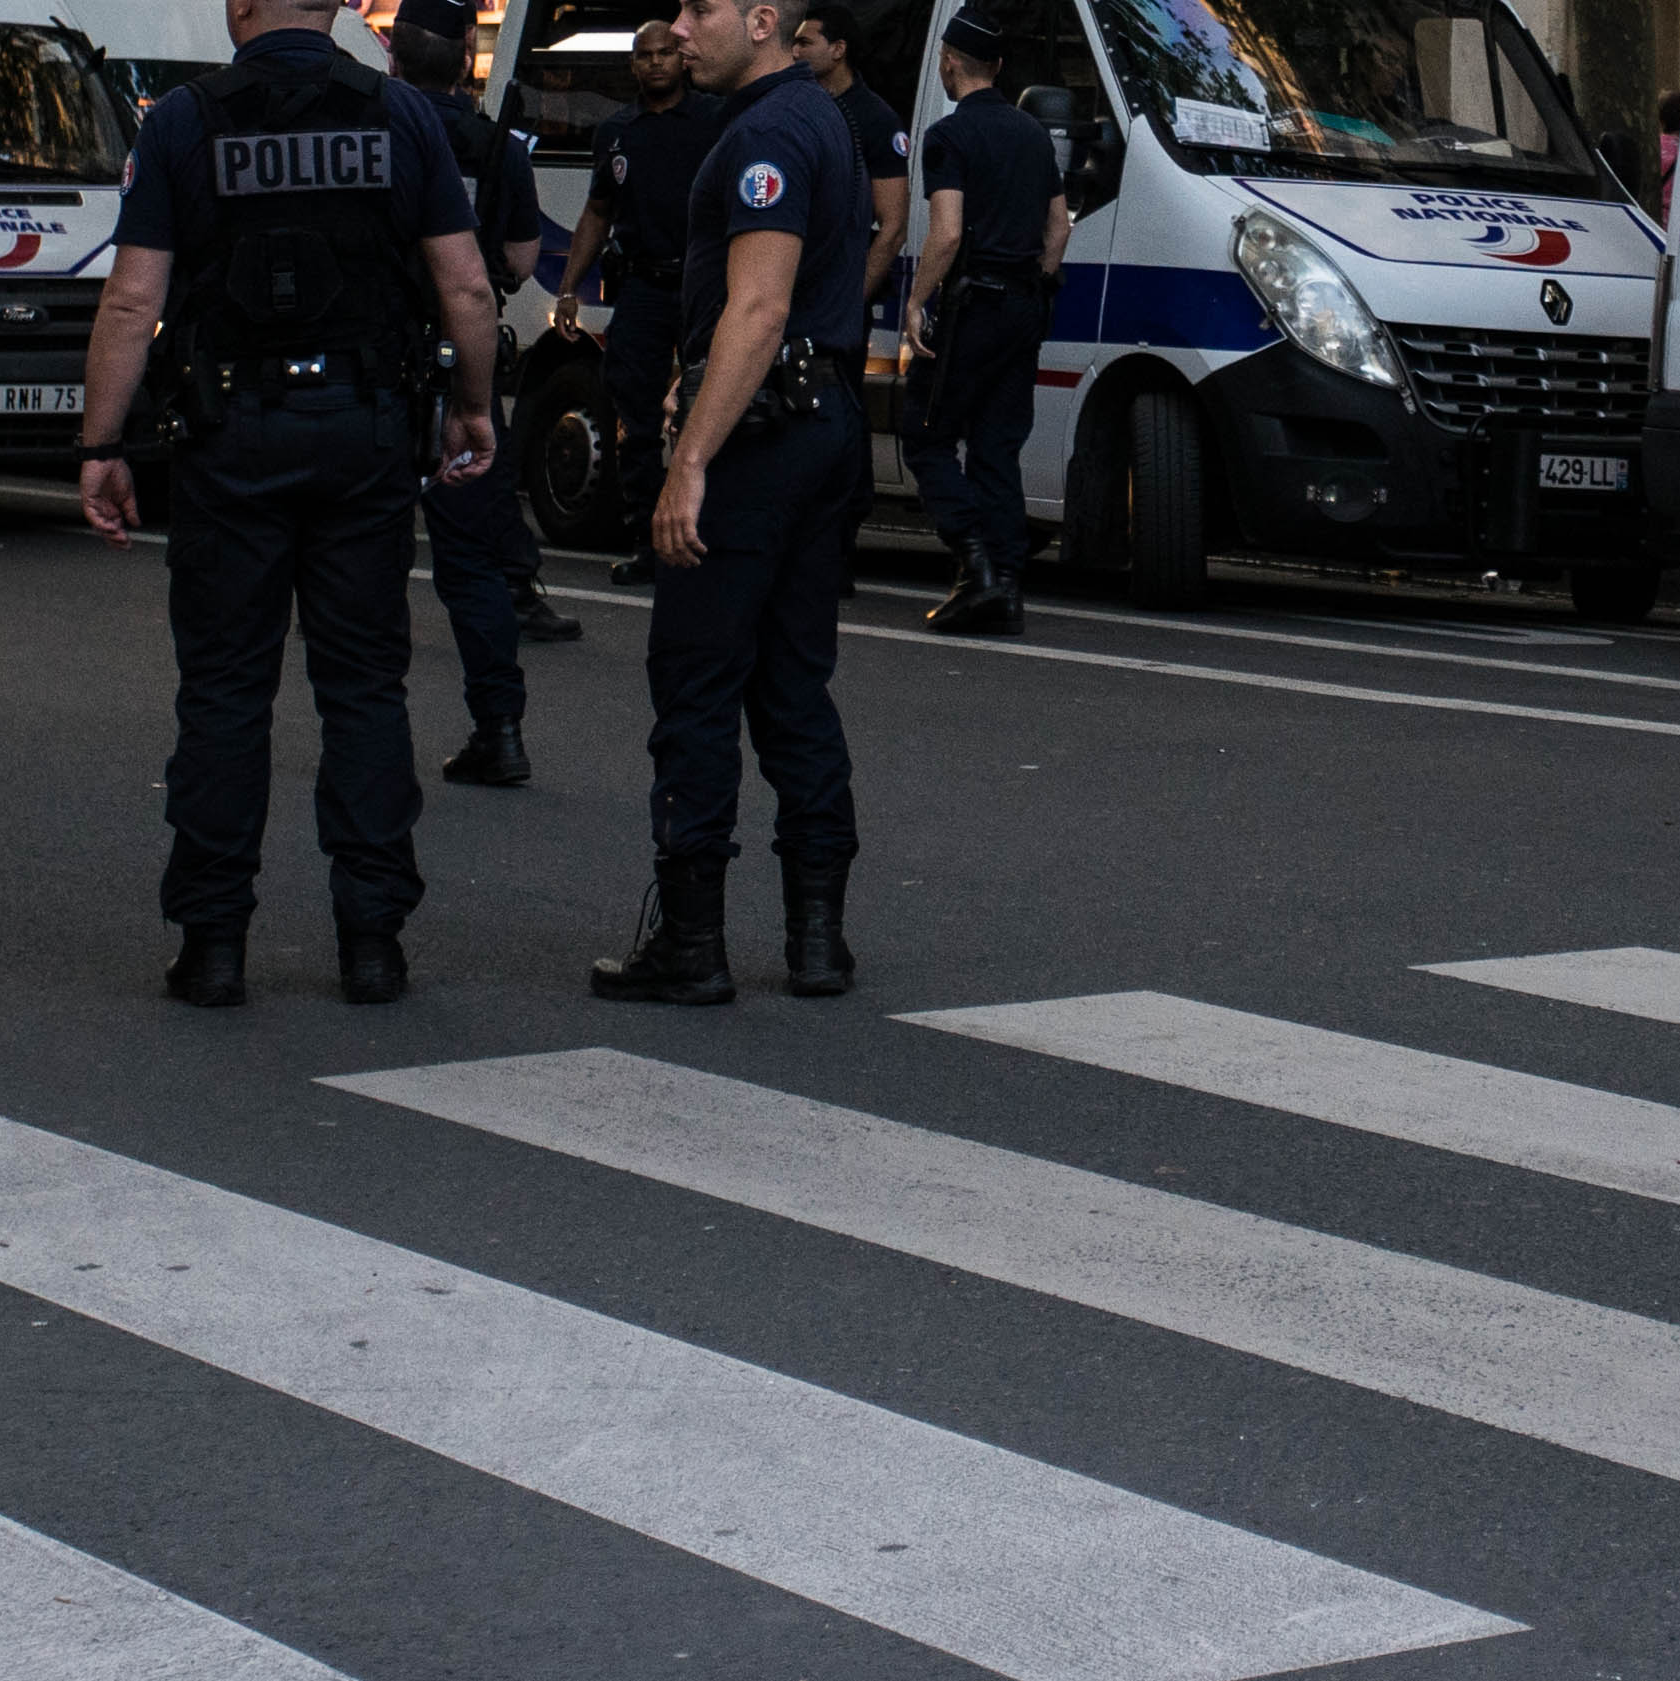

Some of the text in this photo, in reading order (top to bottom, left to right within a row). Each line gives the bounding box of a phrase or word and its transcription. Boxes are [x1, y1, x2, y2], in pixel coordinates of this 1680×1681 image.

[223, 134, 384, 191] POLICE
[1410, 193, 1536, 213] POLICE
[1390, 207, 1590, 233] NATIONALE
[5, 388, 42, 410] RNH
[54, 388, 77, 410] 75
